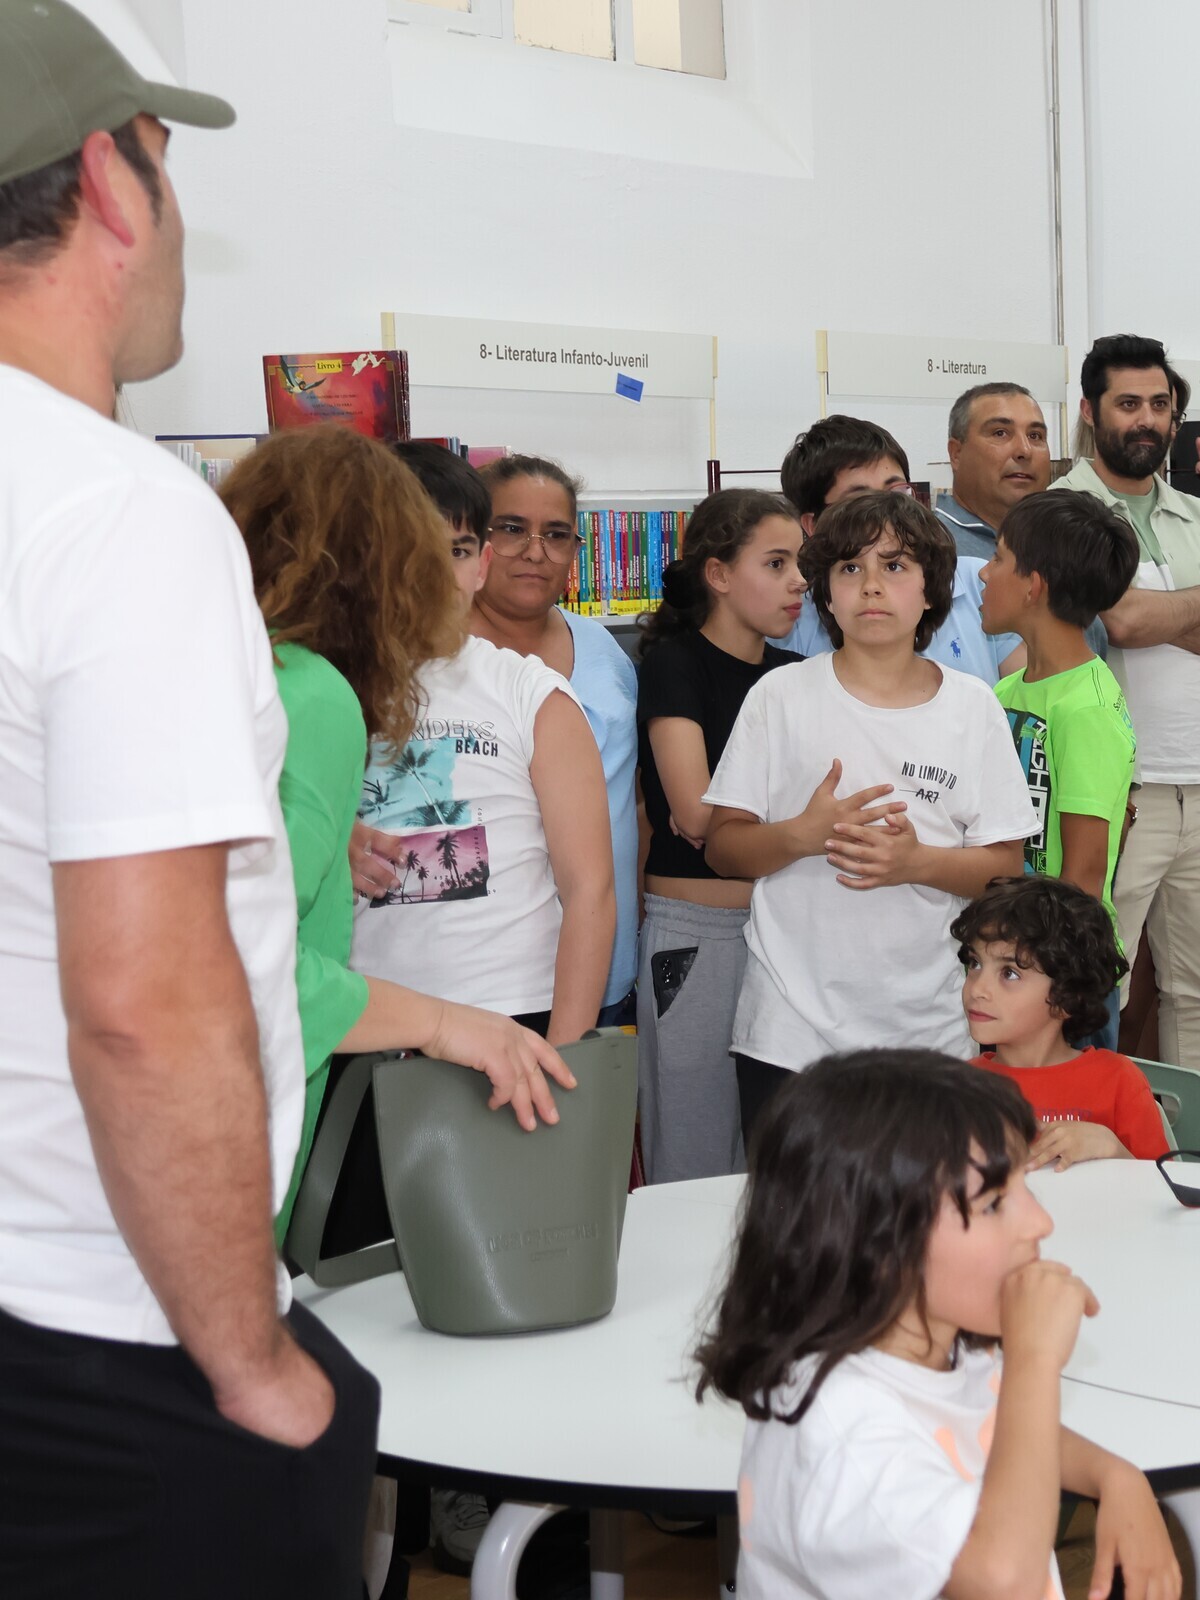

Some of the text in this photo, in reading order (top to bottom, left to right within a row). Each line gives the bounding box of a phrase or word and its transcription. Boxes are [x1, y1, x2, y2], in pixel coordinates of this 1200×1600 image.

[496, 345, 557, 363] Literatura
[561, 349, 648, 368] Infanto-Juvenil
[928, 359, 933, 372] 8
[942, 360, 986, 375] Literatura
[456, 739, 498, 757] BEACH
[902, 761, 957, 790] NO LIMITS TO
[916, 788, 939, 804] ART
